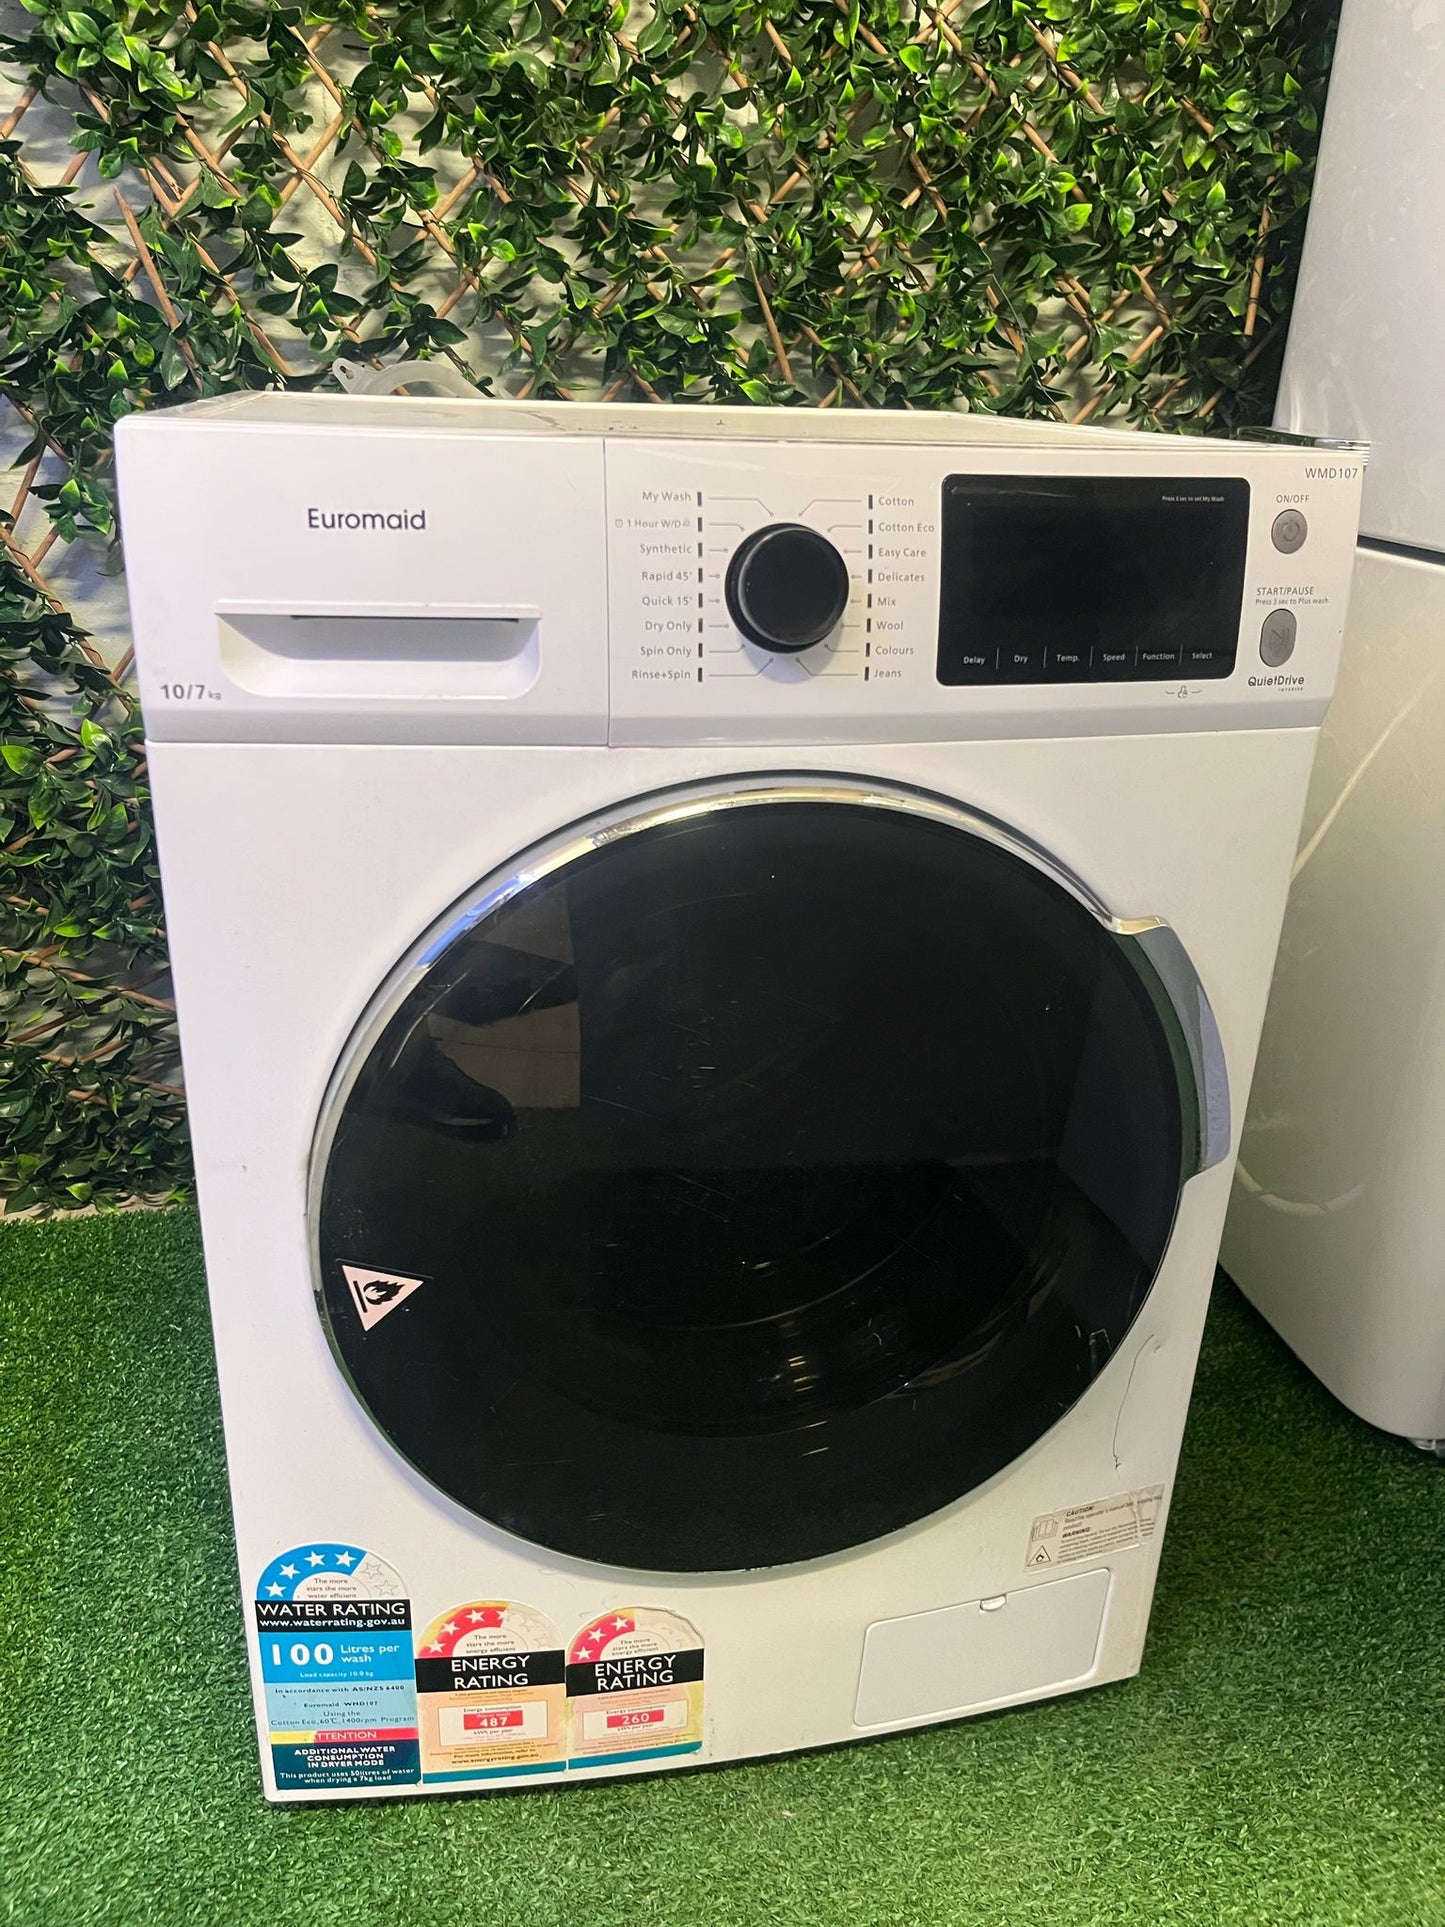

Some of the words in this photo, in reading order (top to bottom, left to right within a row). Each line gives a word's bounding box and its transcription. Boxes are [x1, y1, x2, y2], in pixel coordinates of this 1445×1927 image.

[1305, 468, 1358, 479] WMD107
[642, 492, 659, 503] My
[662, 491, 692, 501] Wash
[878, 496, 915, 506] Cotton
[1276, 494, 1310, 504] ON/OFF
[308, 509, 426, 530] Euromaid
[634, 519, 658, 528] Hour
[661, 519, 682, 528] W/D
[878, 522, 914, 532] Cotton
[917, 523, 935, 533] Eco
[640, 544, 692, 555] Synthetic
[878, 547, 900, 559] Easy
[903, 547, 927, 558] Care
[641, 571, 673, 582] Rapid
[877, 572, 925, 582] Delicates
[1256, 586, 1315, 596] START/PAUSE
[642, 595, 673, 606] Quick
[877, 597, 897, 607] Mix
[645, 621, 664, 632] Dry
[666, 621, 692, 632] Only
[876, 621, 904, 631] Wool
[640, 646, 663, 657] Spin
[666, 646, 692, 657] Only
[875, 646, 914, 655] Colours
[1191, 651, 1213, 660] Select
[963, 655, 986, 665] Delay
[1014, 654, 1028, 664] Dry
[1056, 653, 1081, 663] Temp.
[1102, 653, 1126, 662] Speed
[1142, 652, 1175, 661] Function
[632, 670, 691, 680] Rinse+Spin
[873, 669, 902, 678] Jeans
[1247, 675, 1305, 687] QuietDrive
[161, 684, 206, 700] 10/7
[208, 692, 222, 700] kg
[257, 1603, 327, 1616] WATER
[333, 1602, 406, 1616] RATING
[259, 1618, 406, 1628] www.waterrating.gov.au
[271, 1643, 334, 1666] 100
[340, 1644, 375, 1654] Litres
[379, 1645, 400, 1655] per
[341, 1654, 372, 1663] wash
[451, 1655, 531, 1672] ENERGY
[594, 1654, 677, 1677] ENERGY
[365, 1670, 374, 1678] kg
[454, 1673, 529, 1690] RATING
[597, 1669, 674, 1691] RATING
[480, 1717, 508, 1728] 487
[621, 1713, 650, 1726] 260
[294, 1747, 359, 1756] ADDITIONAL
[360, 1746, 396, 1754] WATER
[307, 1753, 384, 1761] CONSUMPTION
[319, 1760, 353, 1768] DRYER
[298, 1771, 329, 1779] product
[327, 1776, 352, 1784] drying
